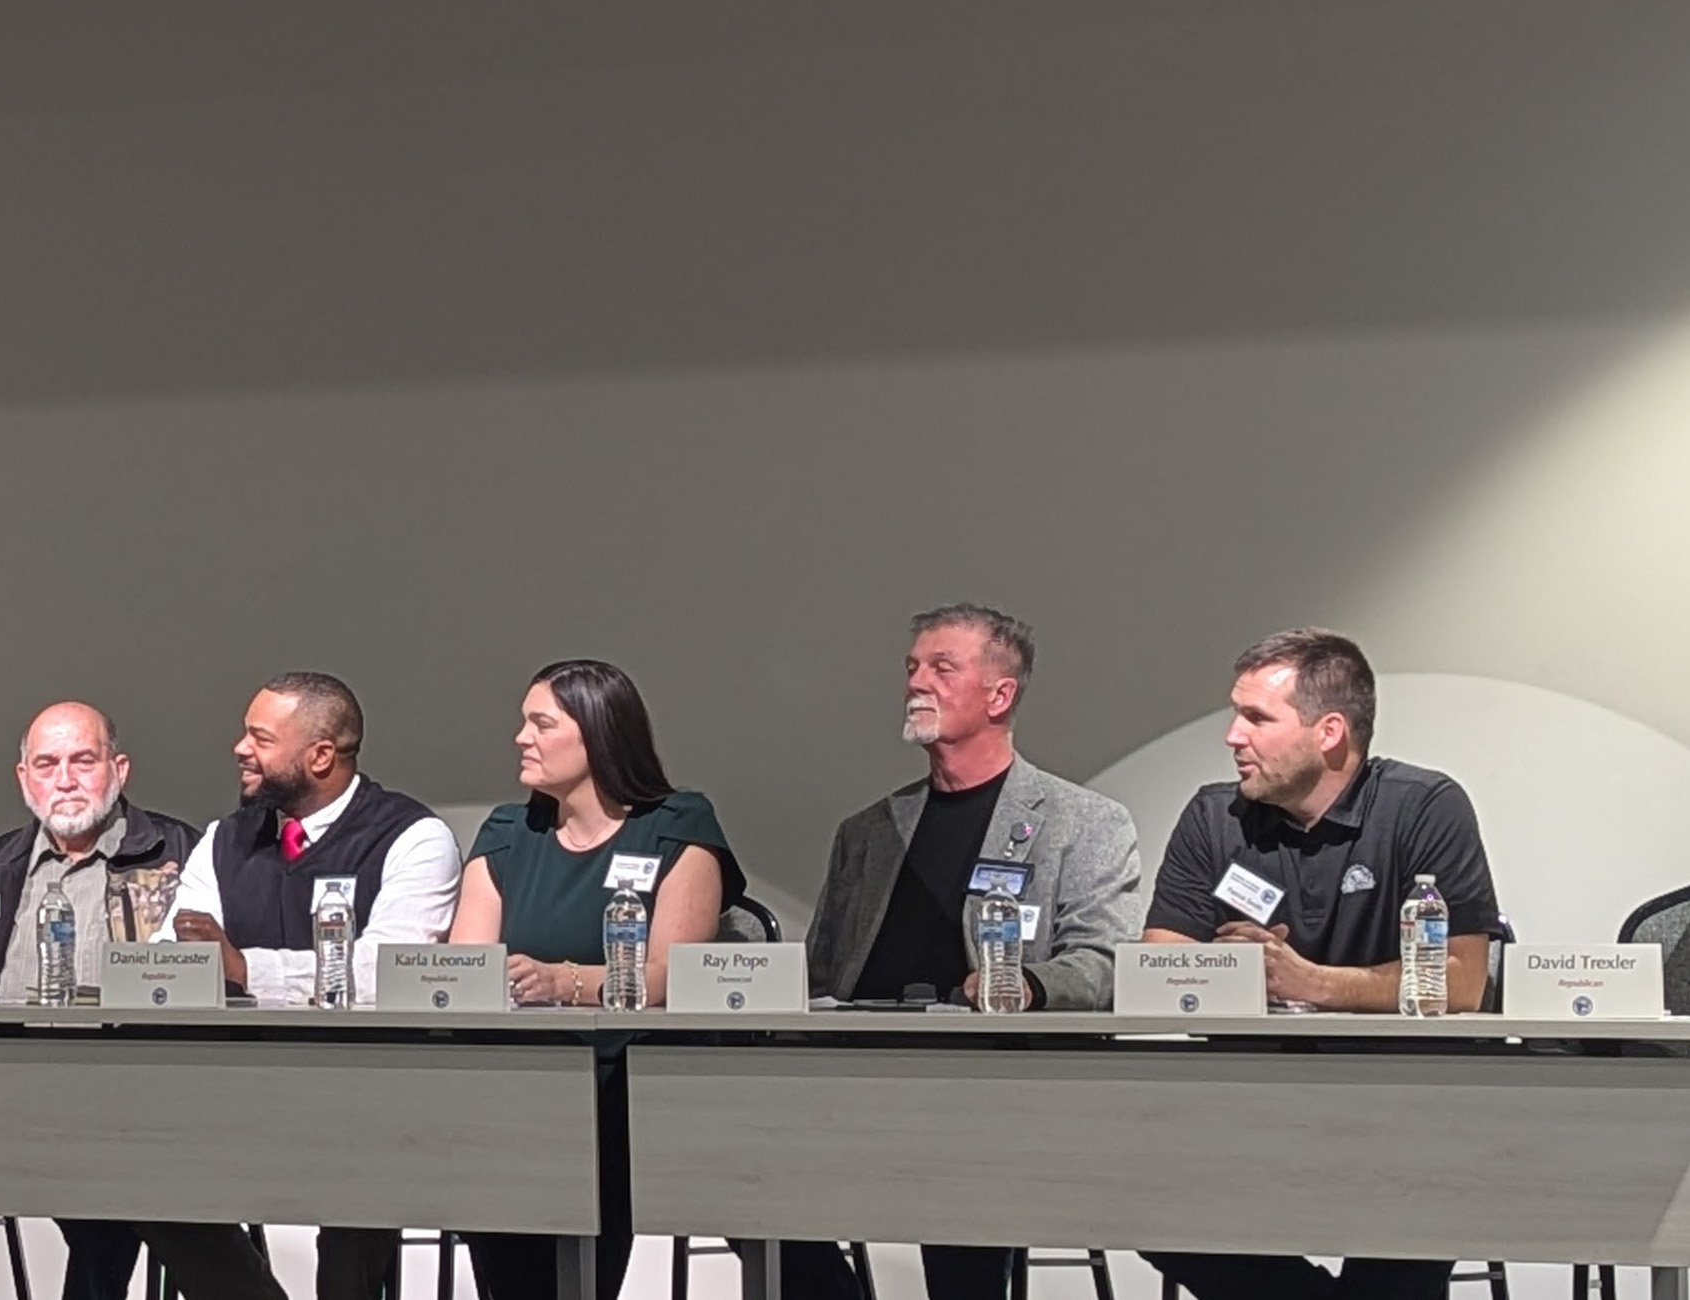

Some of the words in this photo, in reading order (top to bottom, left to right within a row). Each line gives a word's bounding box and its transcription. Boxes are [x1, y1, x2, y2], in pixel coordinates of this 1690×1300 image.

[110, 951, 150, 964] Daniel
[154, 951, 210, 964] Lancaster
[395, 952, 428, 966] Karla
[432, 952, 486, 967] Leonard
[702, 953, 729, 971] Ray
[733, 953, 769, 971] Pope
[1139, 953, 1190, 968] Patrick
[1194, 953, 1238, 968] Smith
[1527, 954, 1576, 969] David
[1580, 954, 1637, 969] Trexler
[1166, 977, 1209, 985] Republican
[1558, 979, 1604, 988] Republican
